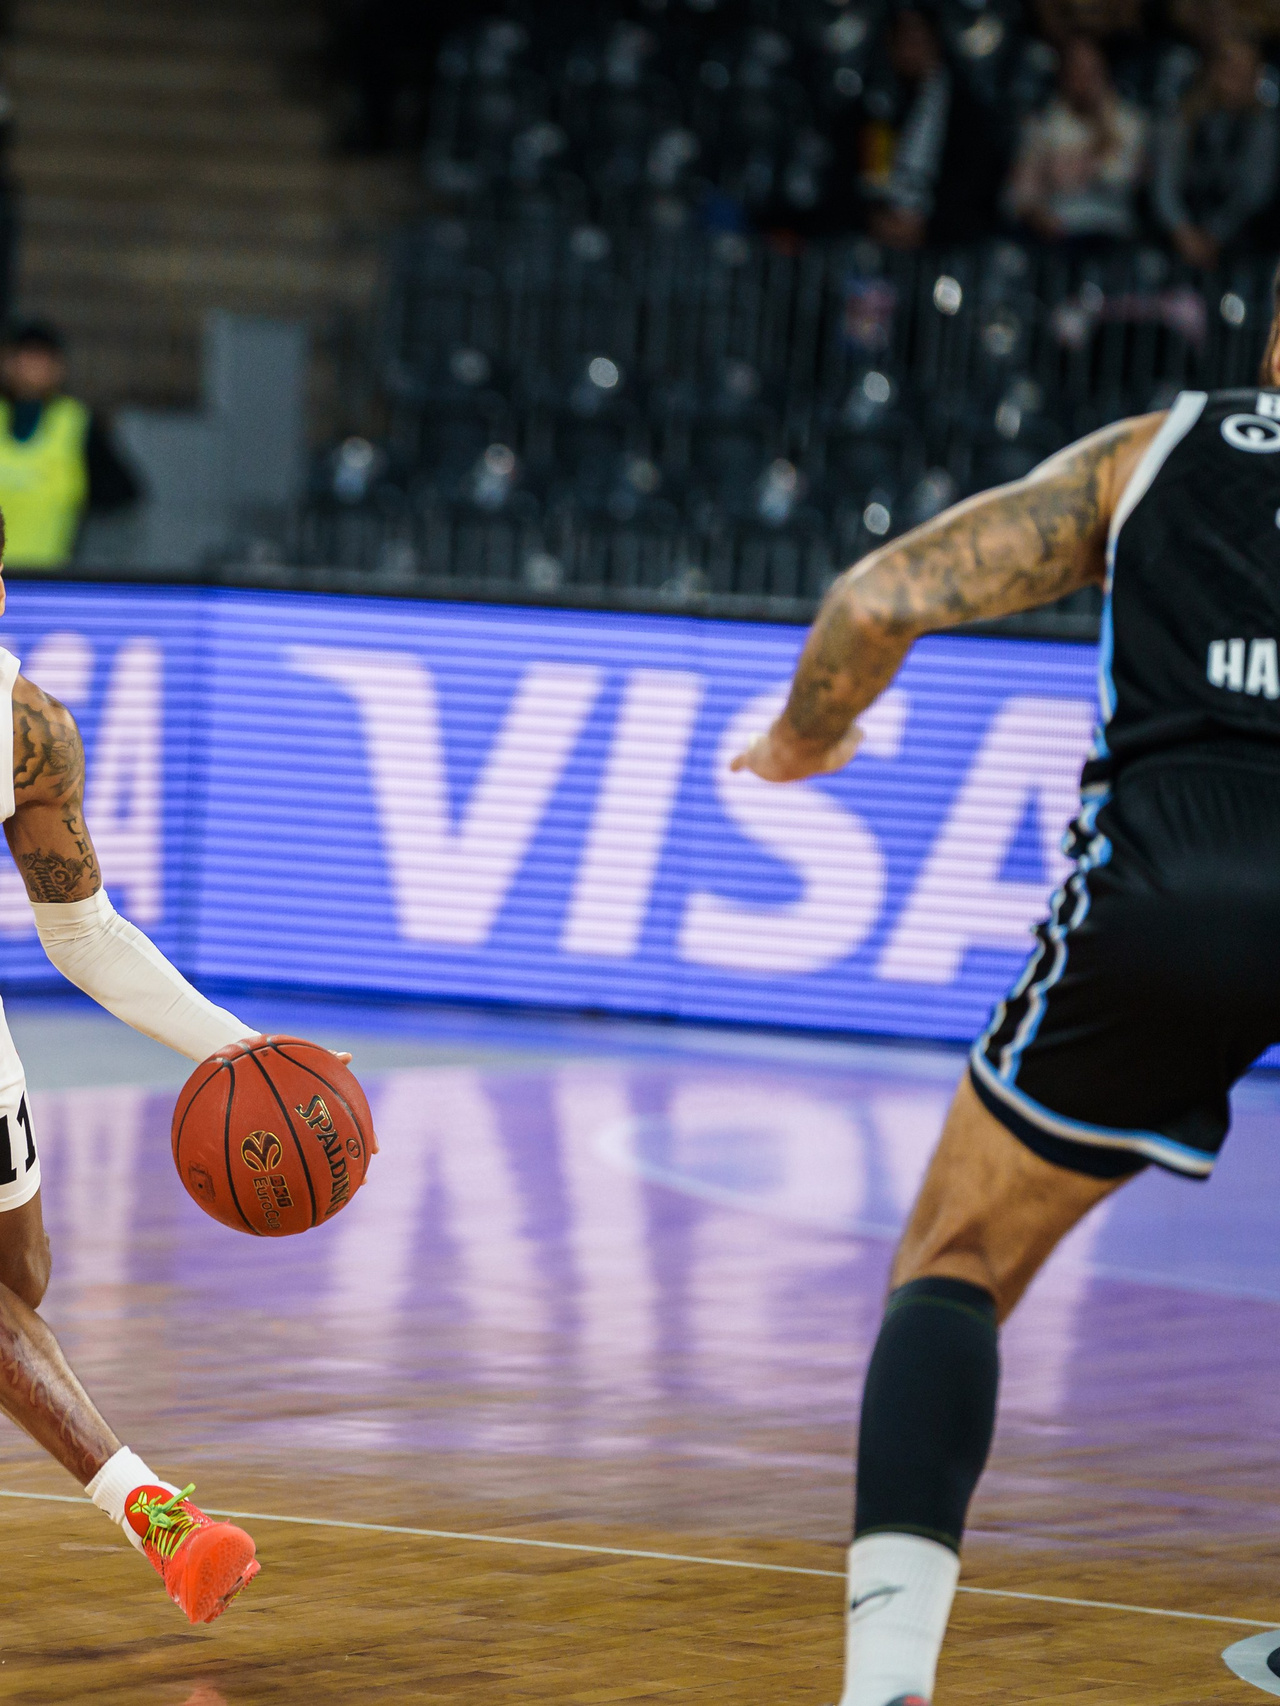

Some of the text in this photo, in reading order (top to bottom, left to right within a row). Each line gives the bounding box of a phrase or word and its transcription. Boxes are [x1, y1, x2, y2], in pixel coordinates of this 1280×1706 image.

[282, 645, 1097, 985] VISA
[253, 1176, 282, 1229] EuroCup
[294, 1094, 350, 1217] SPALDING
